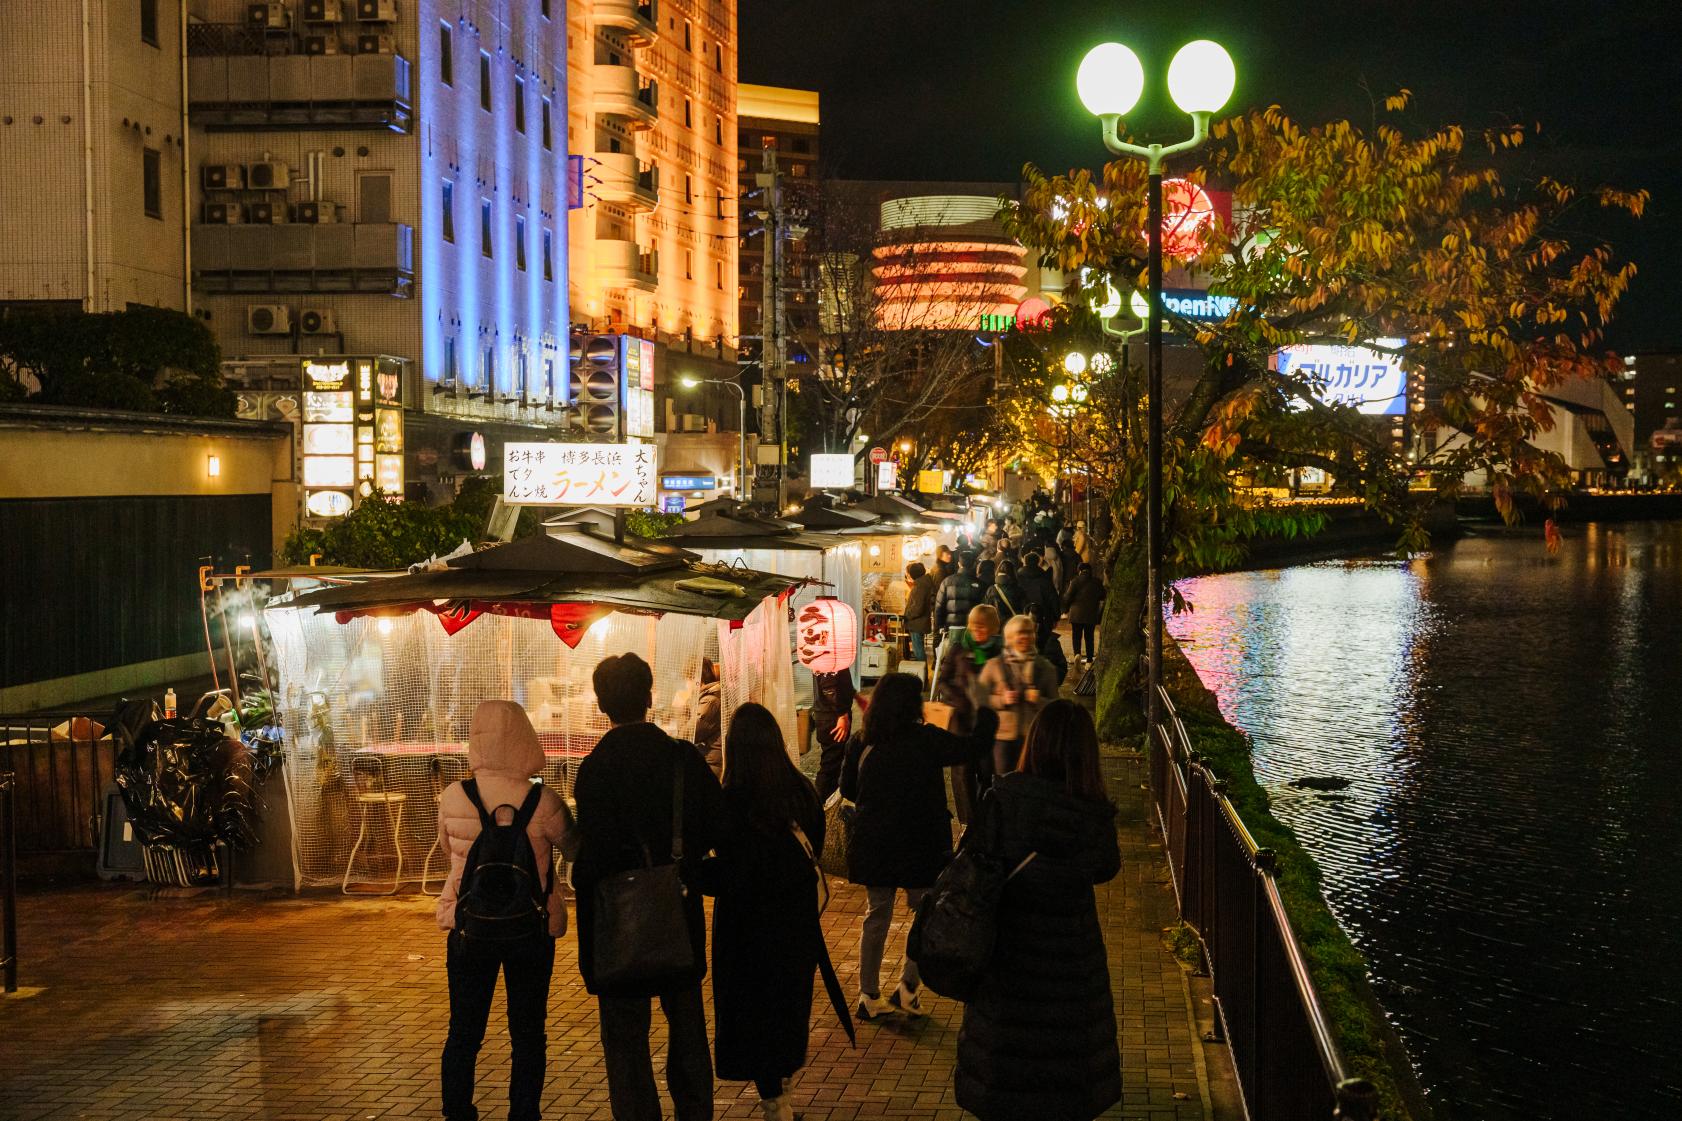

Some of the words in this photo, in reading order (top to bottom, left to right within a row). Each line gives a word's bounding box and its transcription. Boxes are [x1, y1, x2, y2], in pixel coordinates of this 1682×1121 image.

[521, 450, 534, 498] 牛タン
[534, 450, 548, 499] 串焼
[561, 449, 623, 466] 博多長浜
[633, 448, 649, 503] 大ちゃん
[551, 470, 631, 500] ラーメン
